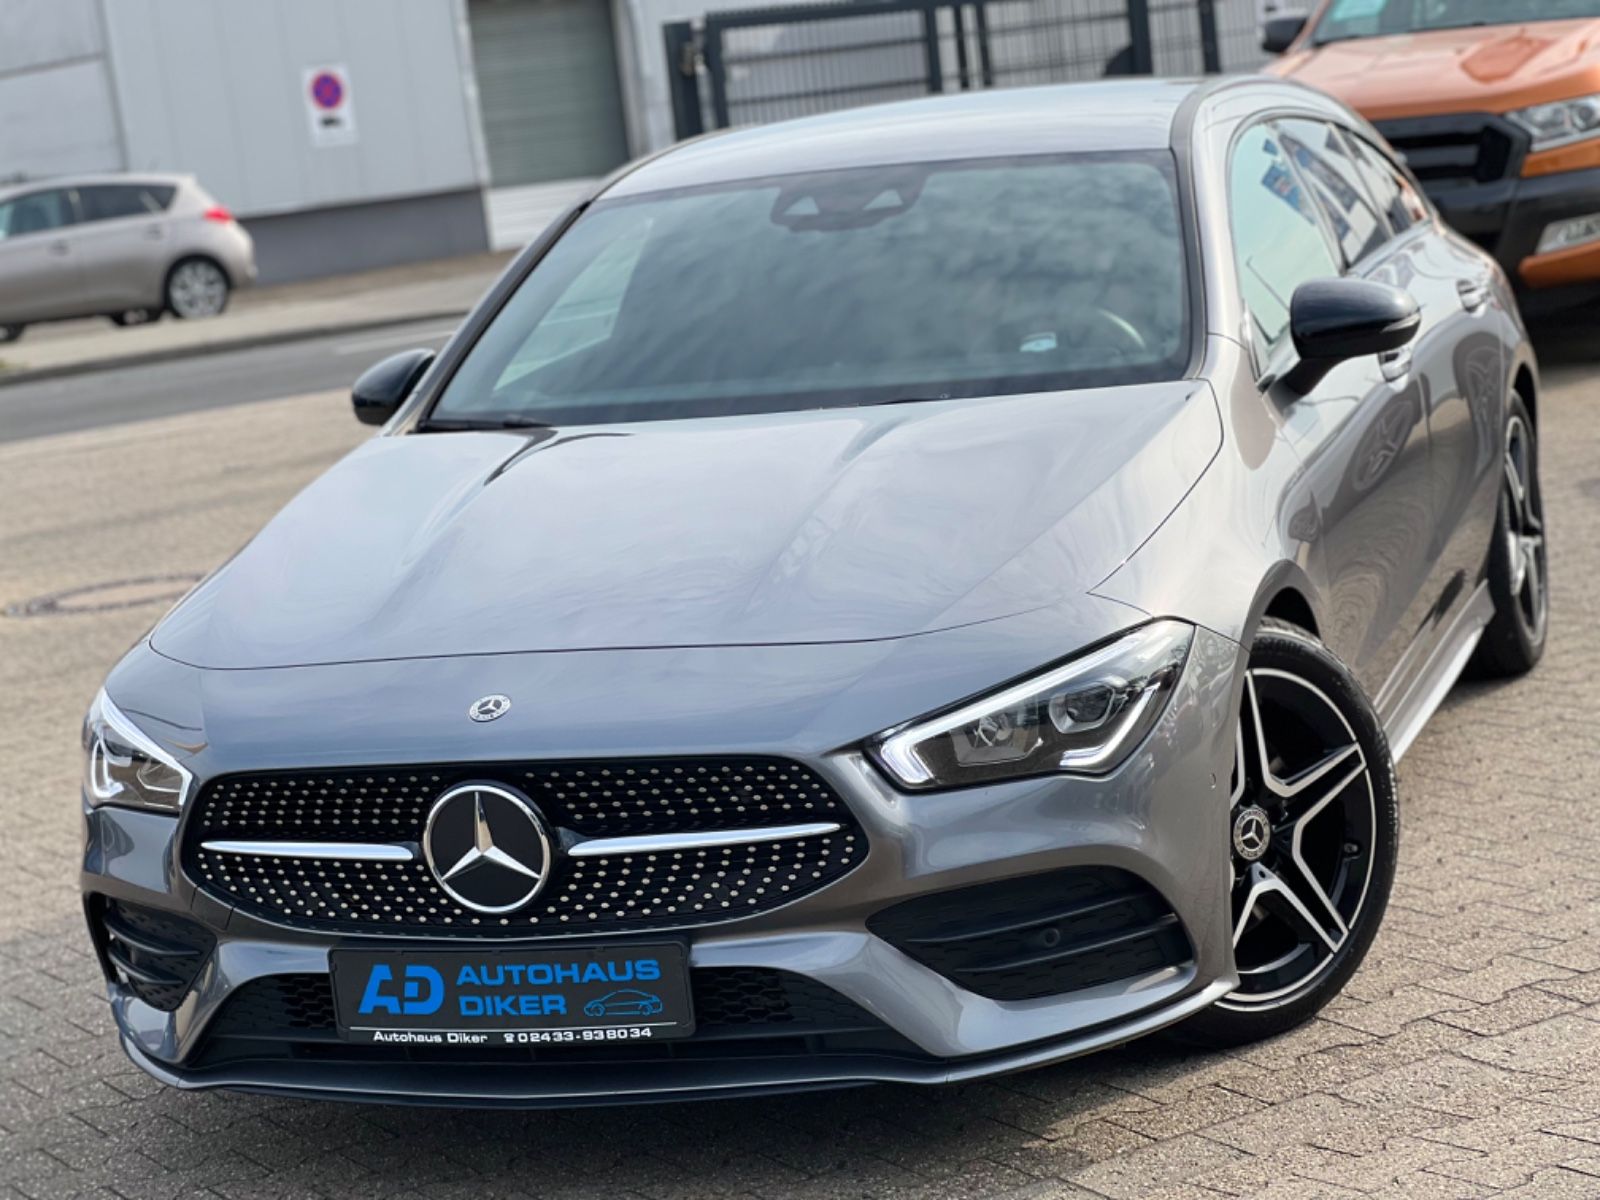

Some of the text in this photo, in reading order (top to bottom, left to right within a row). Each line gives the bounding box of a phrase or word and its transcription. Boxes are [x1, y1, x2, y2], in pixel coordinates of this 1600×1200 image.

[456, 959, 661, 986] AUTOHAUS
[358, 964, 445, 1015] AD
[460, 995, 567, 1016] DIKER
[373, 1031, 442, 1043] Autohaus
[447, 1032, 488, 1043] Diker
